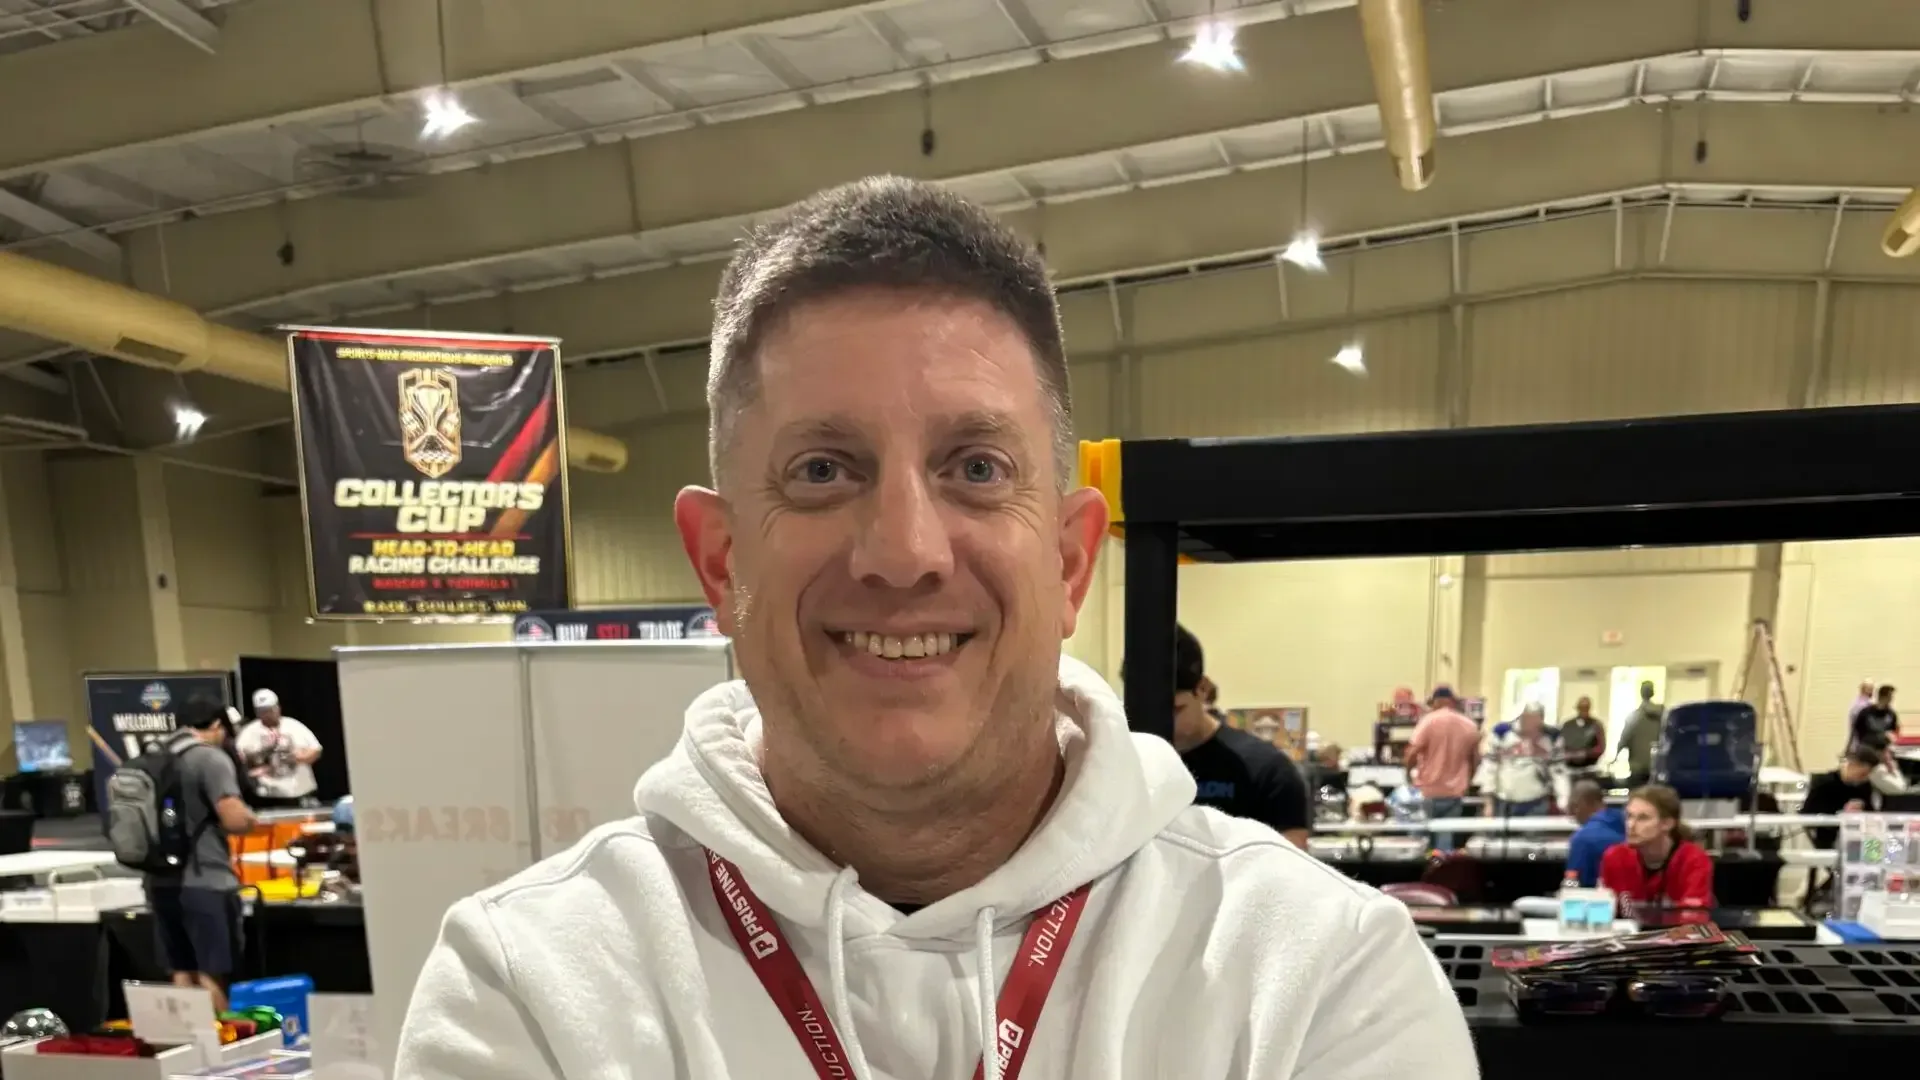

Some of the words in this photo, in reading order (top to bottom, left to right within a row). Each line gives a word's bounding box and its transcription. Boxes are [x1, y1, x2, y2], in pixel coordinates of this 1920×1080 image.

[334, 478, 544, 510] COLLECTOR'S
[396, 505, 487, 533] CUP
[372, 539, 515, 557] HEAD-TO-HEAD
[348, 555, 425, 574] RACING
[427, 556, 540, 574] CHALLENGE
[555, 622, 588, 640] BUY
[112, 712, 168, 732] WELCOME
[715, 863, 763, 936] PRISTINE
[1031, 895, 1073, 966] UCTION
[797, 1010, 847, 1080] UCTION
